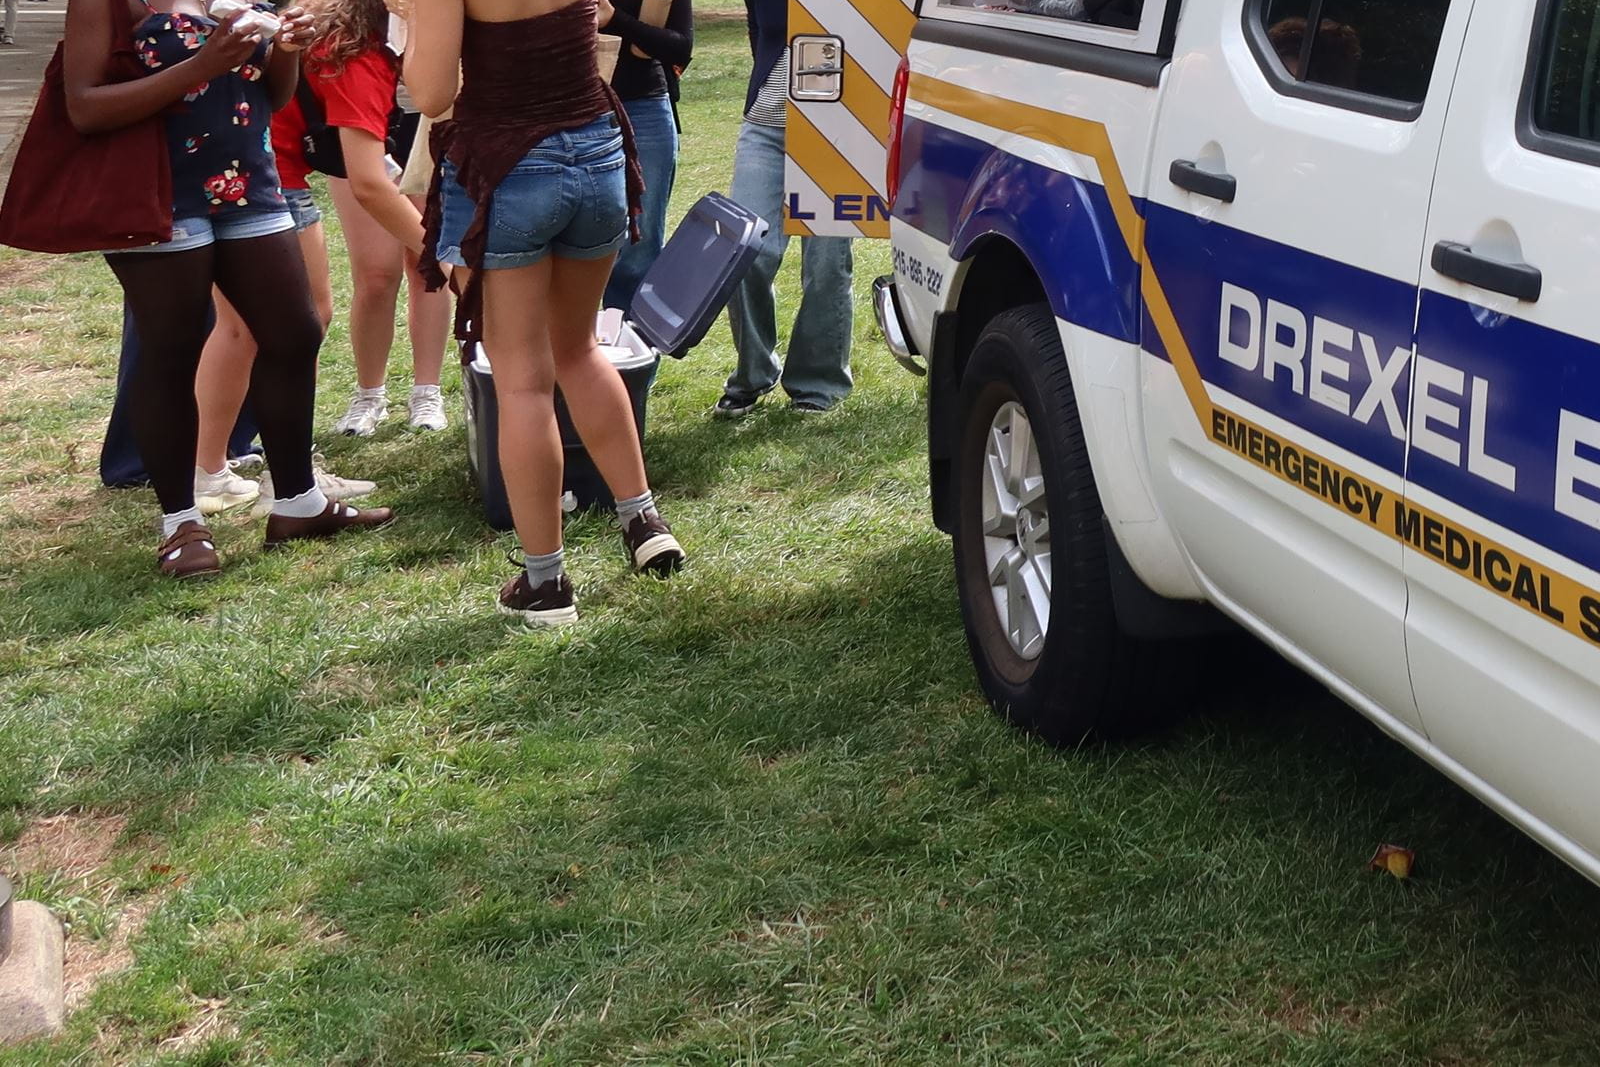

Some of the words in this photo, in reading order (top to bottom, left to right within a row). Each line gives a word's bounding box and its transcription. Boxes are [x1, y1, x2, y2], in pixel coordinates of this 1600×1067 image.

[782, 192, 815, 220] L
[1217, 280, 1516, 492] DREXEL
[1210, 408, 1384, 524] EMERGENCY
[1393, 499, 1565, 622] MEDICAL
